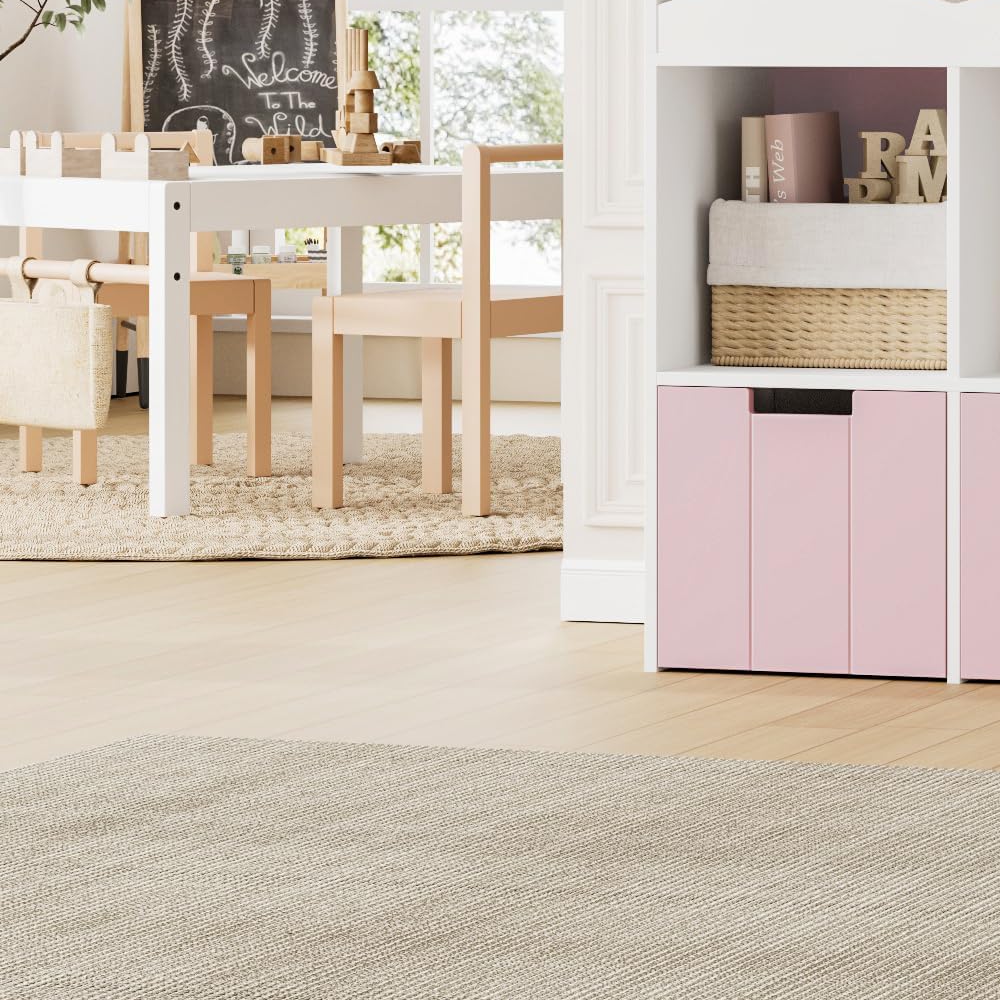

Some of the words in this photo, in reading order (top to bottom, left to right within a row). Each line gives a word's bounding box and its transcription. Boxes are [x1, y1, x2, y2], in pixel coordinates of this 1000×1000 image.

[221, 51, 338, 90] Welcome
[257, 91, 280, 110] To
[280, 91, 316, 110] The
[244, 111, 332, 137] Wild
[769, 138, 785, 184] Web
